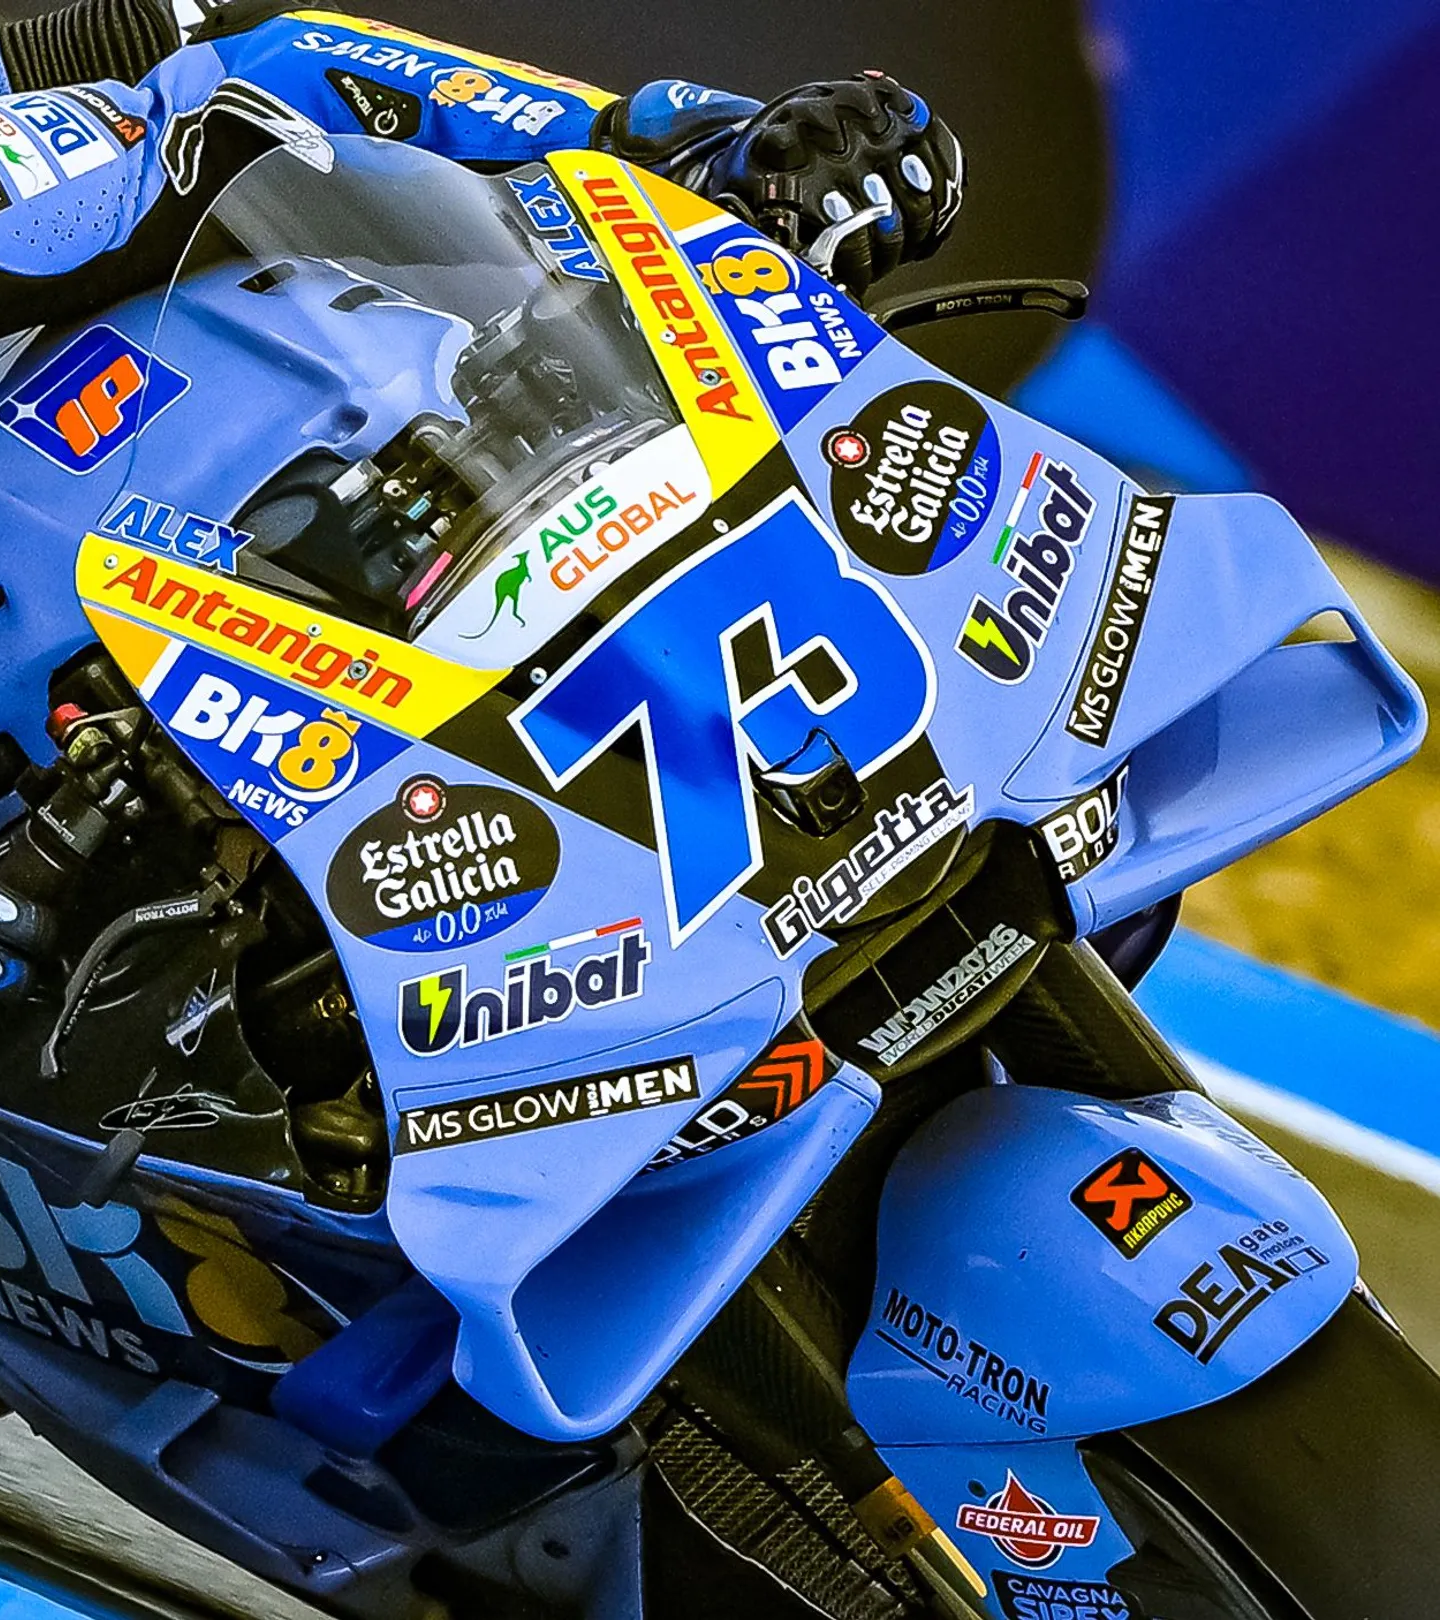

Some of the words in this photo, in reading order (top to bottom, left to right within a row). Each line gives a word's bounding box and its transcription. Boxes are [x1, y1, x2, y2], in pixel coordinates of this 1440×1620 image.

[293, 32, 437, 77] NEWS
[508, 172, 610, 283] ALEX
[583, 177, 753, 423] Antangin
[713, 248, 844, 391] BK8
[809, 293, 862, 360] NEWS
[851, 403, 931, 535] Estrella
[891, 424, 970, 543] Galicia
[100, 494, 255, 574] ALEX
[538, 483, 618, 564] AUS
[548, 479, 696, 592] GLOBAL
[103, 556, 413, 709] Antangin
[1093, 588, 1139, 689] GLOW
[169, 672, 362, 789] BK8
[228, 778, 309, 827] NEWS
[360, 811, 517, 882] Estrella
[375, 852, 521, 919] Galicia
[760, 780, 972, 959] Gigetta
[398, 931, 652, 1057] Unibat
[406, 1109, 461, 1144] MS
[467, 1085, 580, 1132] GLOW
[600, 1064, 692, 1108] MEN
[1238, 1219, 1290, 1252] gate
[882, 1288, 1048, 1417] MOTO-TRON
[946, 1373, 1047, 1434] RACING
[964, 1511, 1047, 1537] FEDERAL
[1053, 1521, 1085, 1540] OIL
[1007, 1579, 1128, 1607] CAVAGNA
